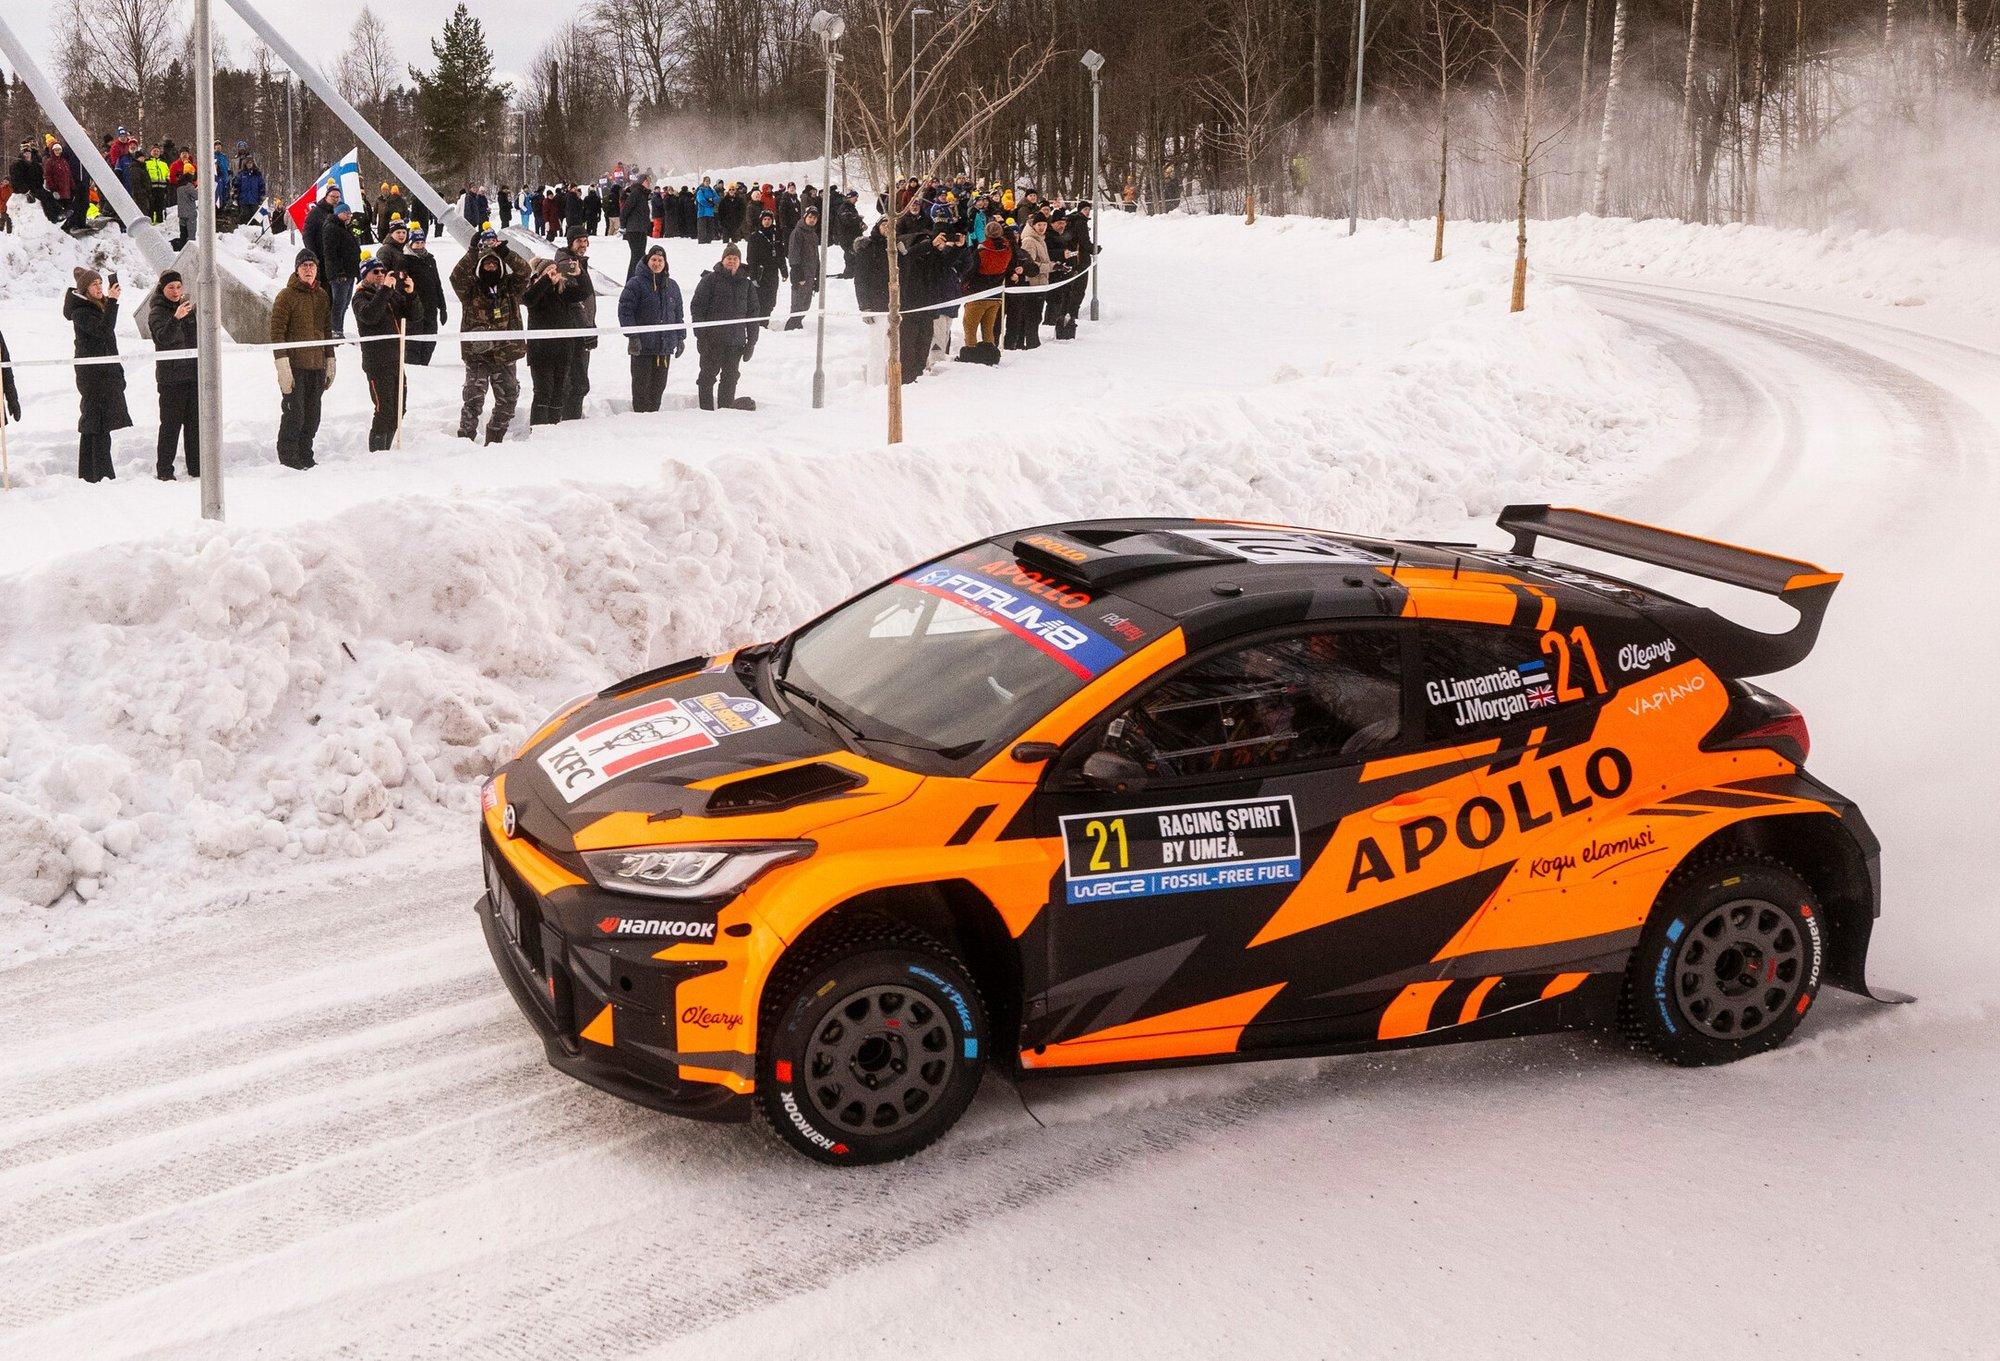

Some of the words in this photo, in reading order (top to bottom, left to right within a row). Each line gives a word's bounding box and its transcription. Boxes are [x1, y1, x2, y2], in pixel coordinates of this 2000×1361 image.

[1025, 534, 1088, 560] APOLLO
[978, 561, 1092, 609] APOLLO
[937, 574, 1088, 650] FORUM8
[1540, 625, 1609, 703] 21
[1618, 638, 1676, 671] O'Learys
[1426, 666, 1522, 705] G.Linnamäe
[1628, 674, 1706, 716] VAPIANO
[1455, 692, 1530, 726] J.Morgan
[548, 746, 595, 789] KFC
[1158, 812, 1223, 838] RACING
[1227, 805, 1281, 831] SPIRIT
[1346, 747, 1633, 893] APOLLO
[1086, 818, 1129, 871] 21
[1162, 841, 1185, 864] BY
[1190, 831, 1244, 861] UMEÅ.
[1530, 855, 1577, 882] Kogu
[1582, 825, 1656, 864] elamusi
[1074, 879, 1145, 898] WRC2
[1161, 868, 1253, 890] FOSSIL-FREE
[1258, 864, 1294, 881] FUEL
[682, 1006, 743, 1030] O'Learys
